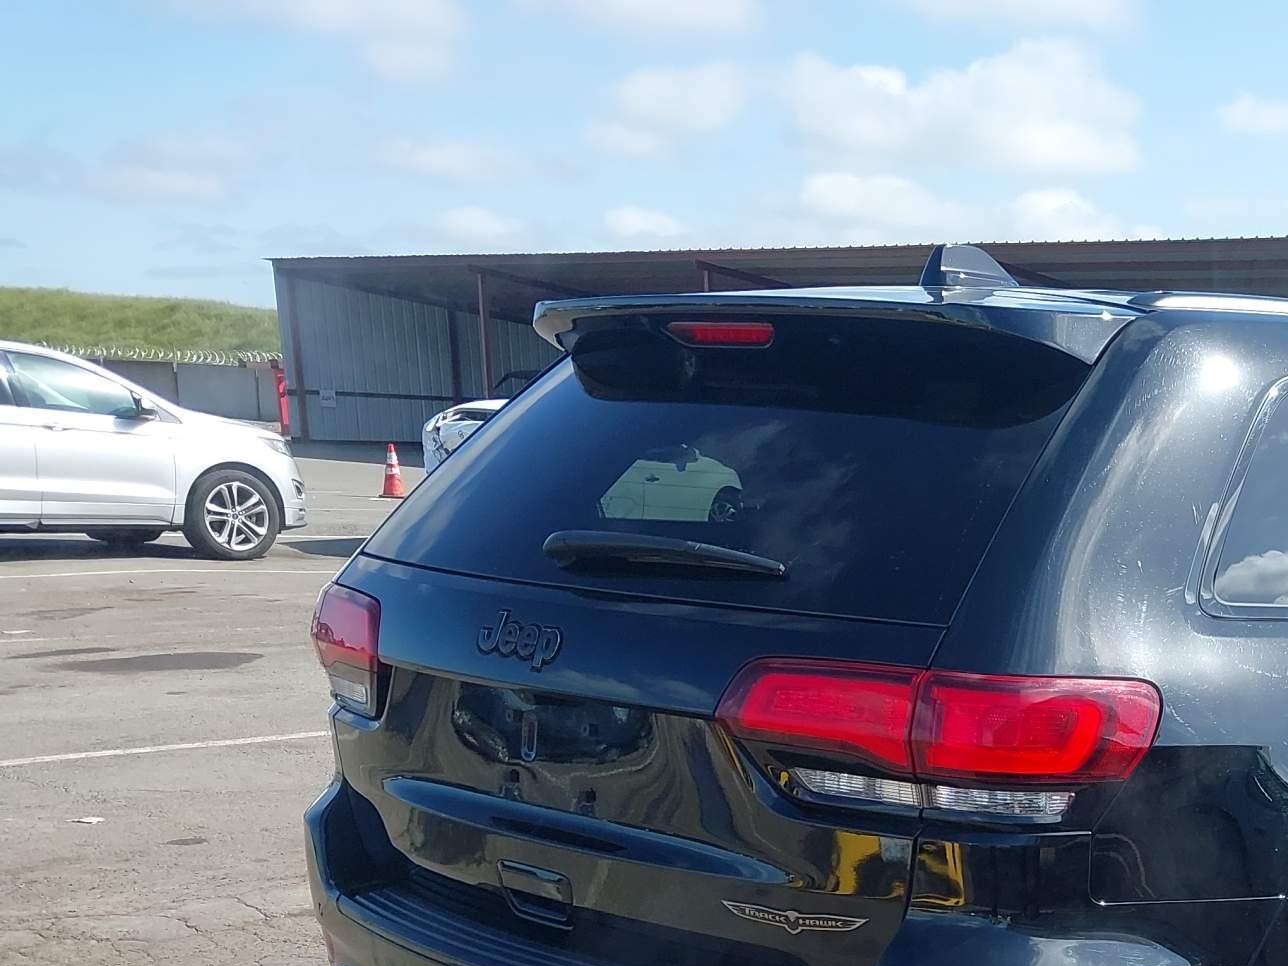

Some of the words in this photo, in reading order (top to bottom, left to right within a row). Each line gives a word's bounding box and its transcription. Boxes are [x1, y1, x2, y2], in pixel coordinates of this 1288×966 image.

[477, 608, 563, 673] Jeep
[744, 906, 788, 923] TRACK
[799, 918, 845, 928] HAWK
